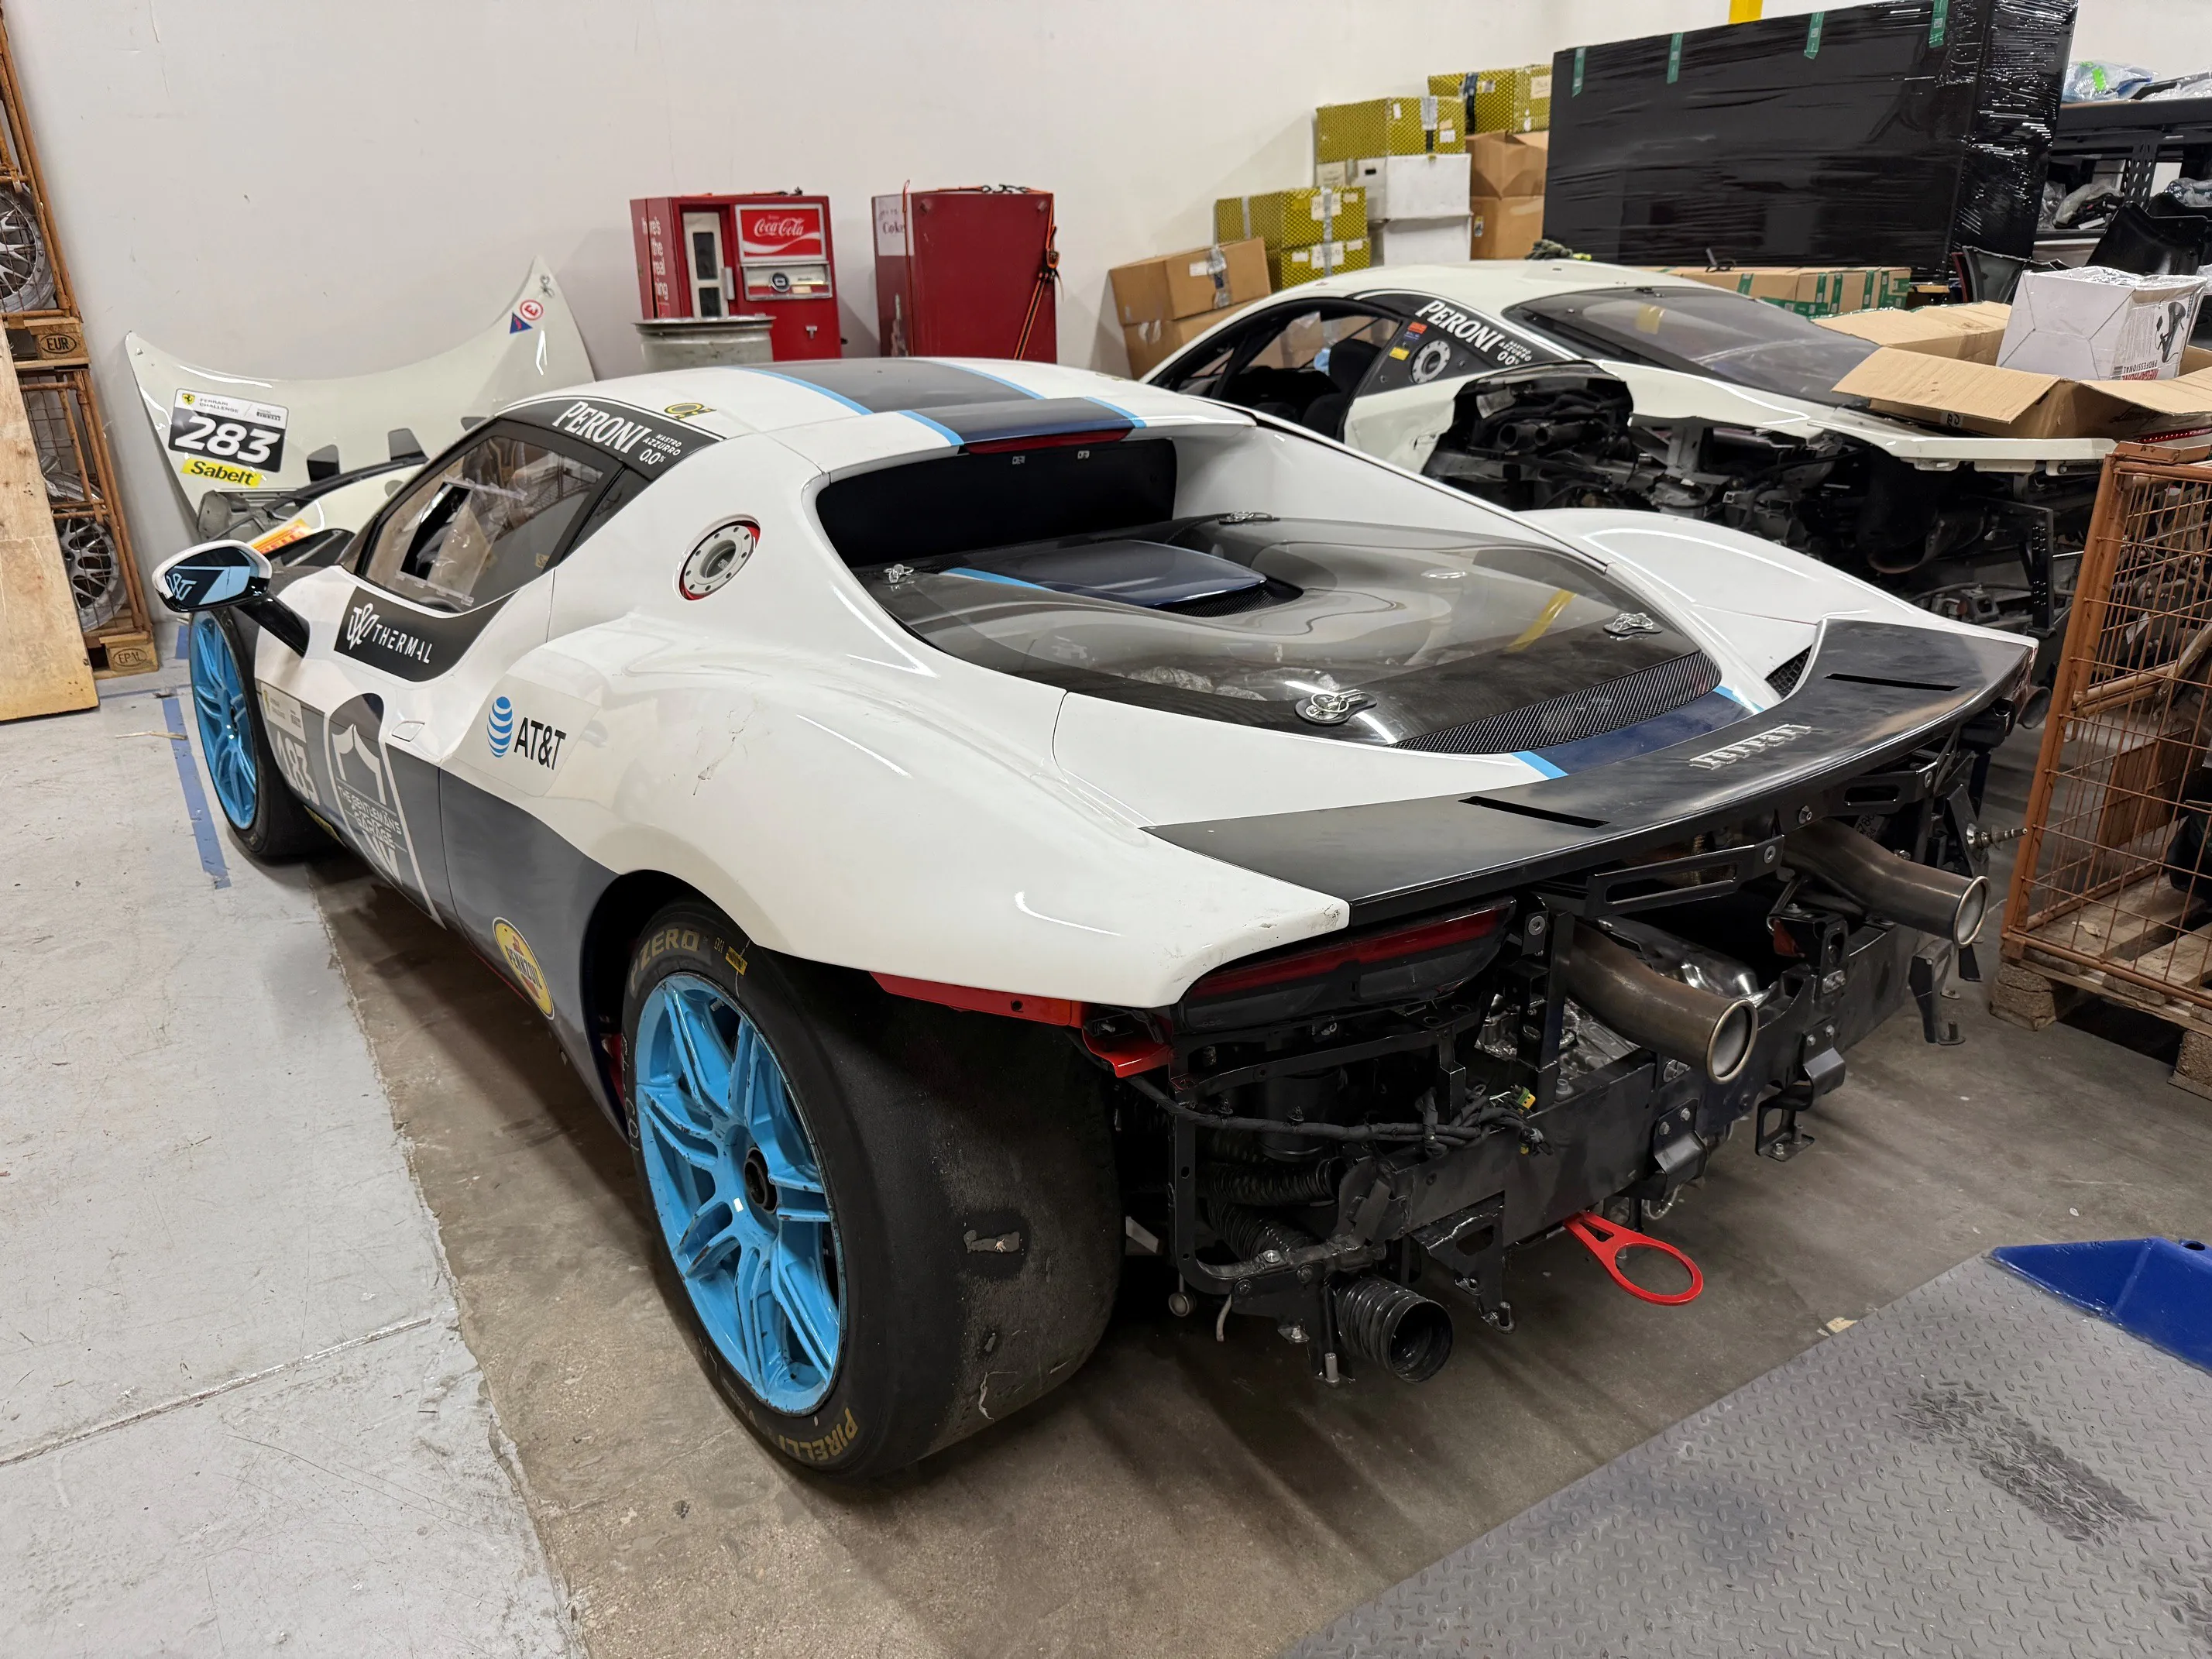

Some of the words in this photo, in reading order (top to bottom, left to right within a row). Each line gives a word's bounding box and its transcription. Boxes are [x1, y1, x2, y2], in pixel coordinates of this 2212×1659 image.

[754, 217, 805, 238] Coca-Cola
[1415, 300, 1505, 353] PERONI
[46, 337, 70, 351] EUR
[2123, 360, 2159, 373] PROFESSIONAL
[199, 402, 239, 414] CHALLENGE
[175, 416, 280, 463] 283
[552, 401, 652, 454] PERONI
[655, 434, 682, 448] NASTRO
[642, 437, 681, 455] AZZURRO
[191, 461, 255, 486] Sabelt
[372, 623, 433, 664] THERMAL
[514, 717, 567, 771] AT&T
[277, 730, 320, 805] 183
[778, 1407, 858, 1462] PIRELLI
